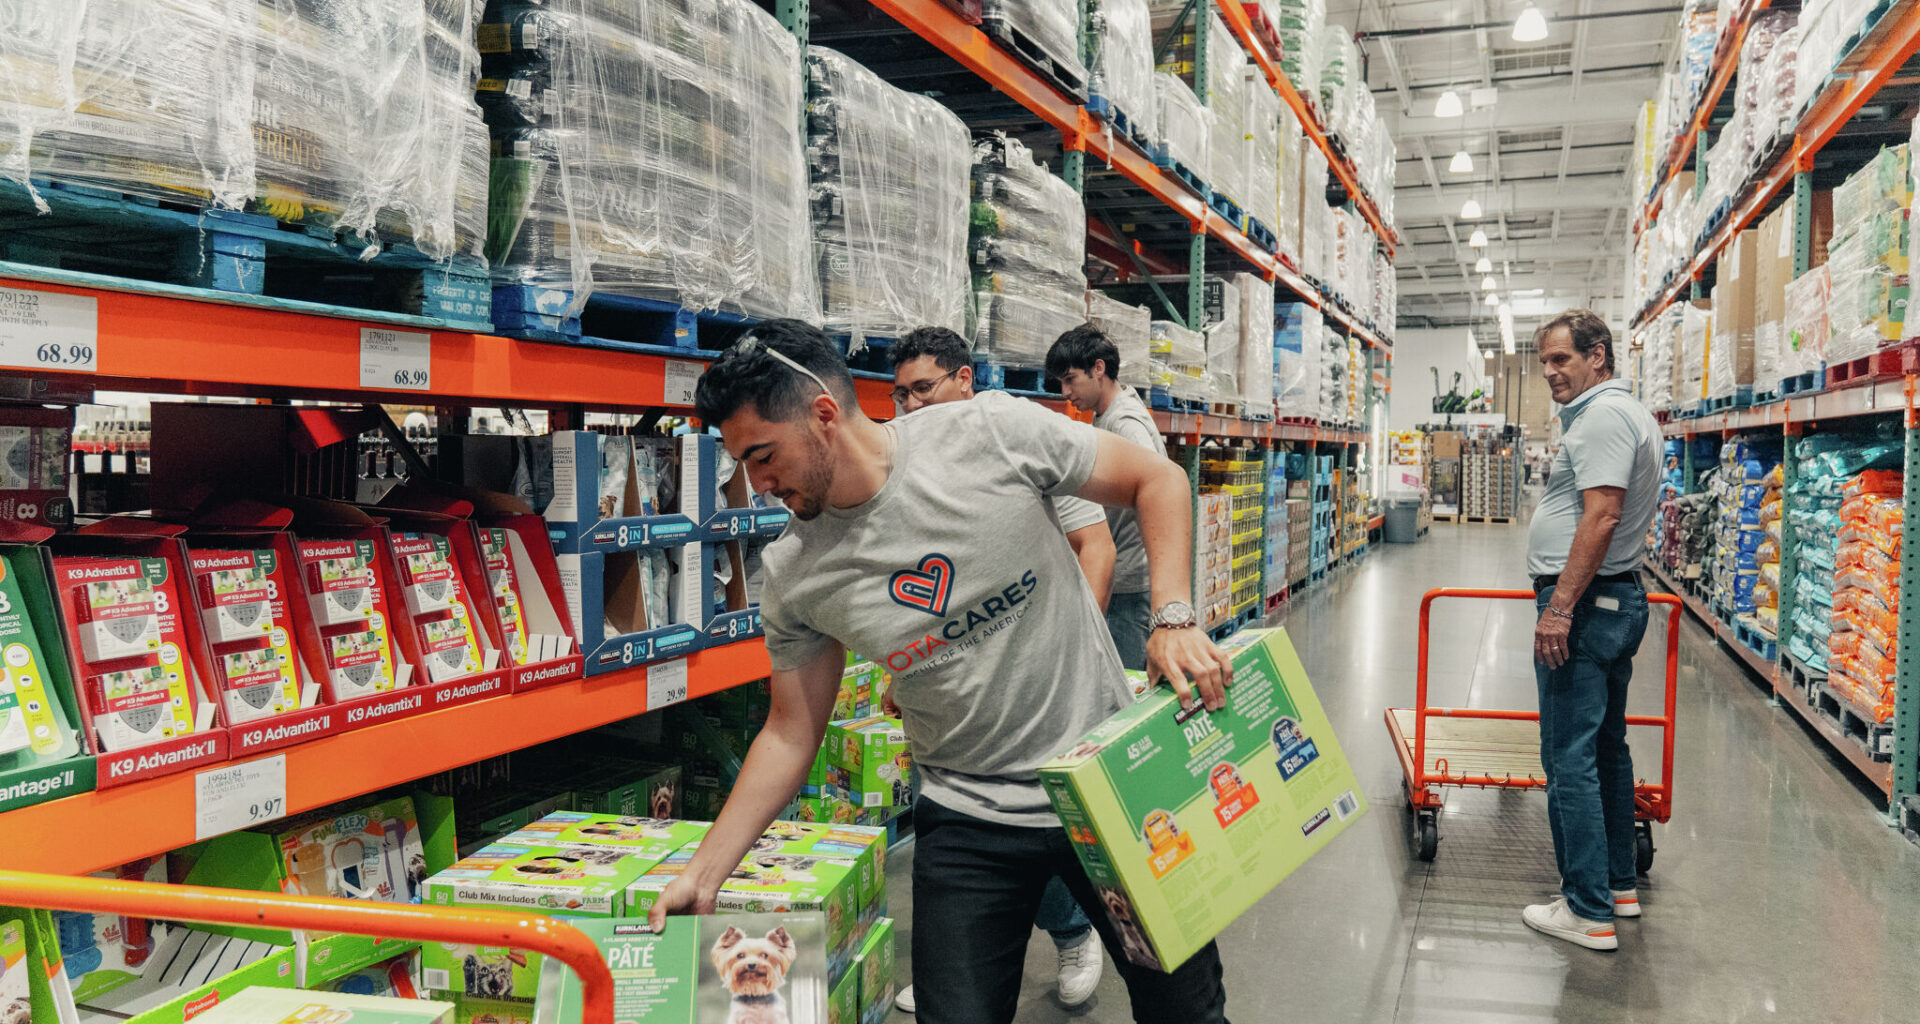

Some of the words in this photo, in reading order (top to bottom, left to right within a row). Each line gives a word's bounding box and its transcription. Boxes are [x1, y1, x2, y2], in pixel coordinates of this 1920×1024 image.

[0, 292, 38, 306] 791222
[37, 344, 92, 365] 68.99
[394, 369, 428, 385] 68.99
[618, 525, 628, 548] 8
[630, 530, 640, 540] IN
[642, 524, 650, 545] 1
[730, 516, 738, 536] 8
[740, 520, 748, 529] IN
[749, 515, 755, 533] 1
[194, 560, 206, 568] K9
[207, 557, 242, 567] Advantix
[303, 549, 314, 557] K9
[315, 546, 346, 556] Advantix
[68, 569, 83, 579] K9
[85, 566, 128, 578] Advantix
[129, 565, 136, 574] II
[265, 580, 278, 600] 8
[152, 591, 169, 613] 8
[729, 619, 737, 638] 8
[738, 620, 747, 630] IN
[747, 615, 754, 633] 1
[875, 569, 1037, 671] OTACARES
[623, 642, 632, 664] 8
[635, 645, 645, 656] IN
[647, 638, 655, 659] 1
[940, 650, 955, 663] OF
[958, 636, 980, 651] THE
[520, 670, 533, 684] K9
[534, 664, 571, 680] Advantix
[571, 662, 576, 674] II
[436, 688, 450, 703] K9
[452, 680, 494, 699] Advantix
[494, 677, 500, 689] II
[667, 687, 686, 702] 29.99
[347, 708, 363, 723] K9
[365, 698, 413, 719] Advantix
[414, 695, 422, 707] II
[243, 731, 262, 748] K9
[264, 718, 322, 742] Advantix
[323, 715, 330, 728] II
[1182, 708, 1216, 746] PÂTÉ
[111, 762, 134, 777] K9
[136, 743, 207, 772] Advantix
[207, 740, 216, 755] II
[1282, 759, 1294, 774] 15
[0, 776, 61, 801] antage
[65, 770, 75, 786] II
[250, 798, 282, 821] 9.97
[1220, 806, 1232, 822] 15
[1153, 856, 1166, 872] 15
[459, 891, 478, 900] Club
[481, 892, 496, 901] Mix
[498, 893, 536, 904] Includes
[714, 901, 743, 910] cludes
[608, 942, 655, 968] PÂTÉ
